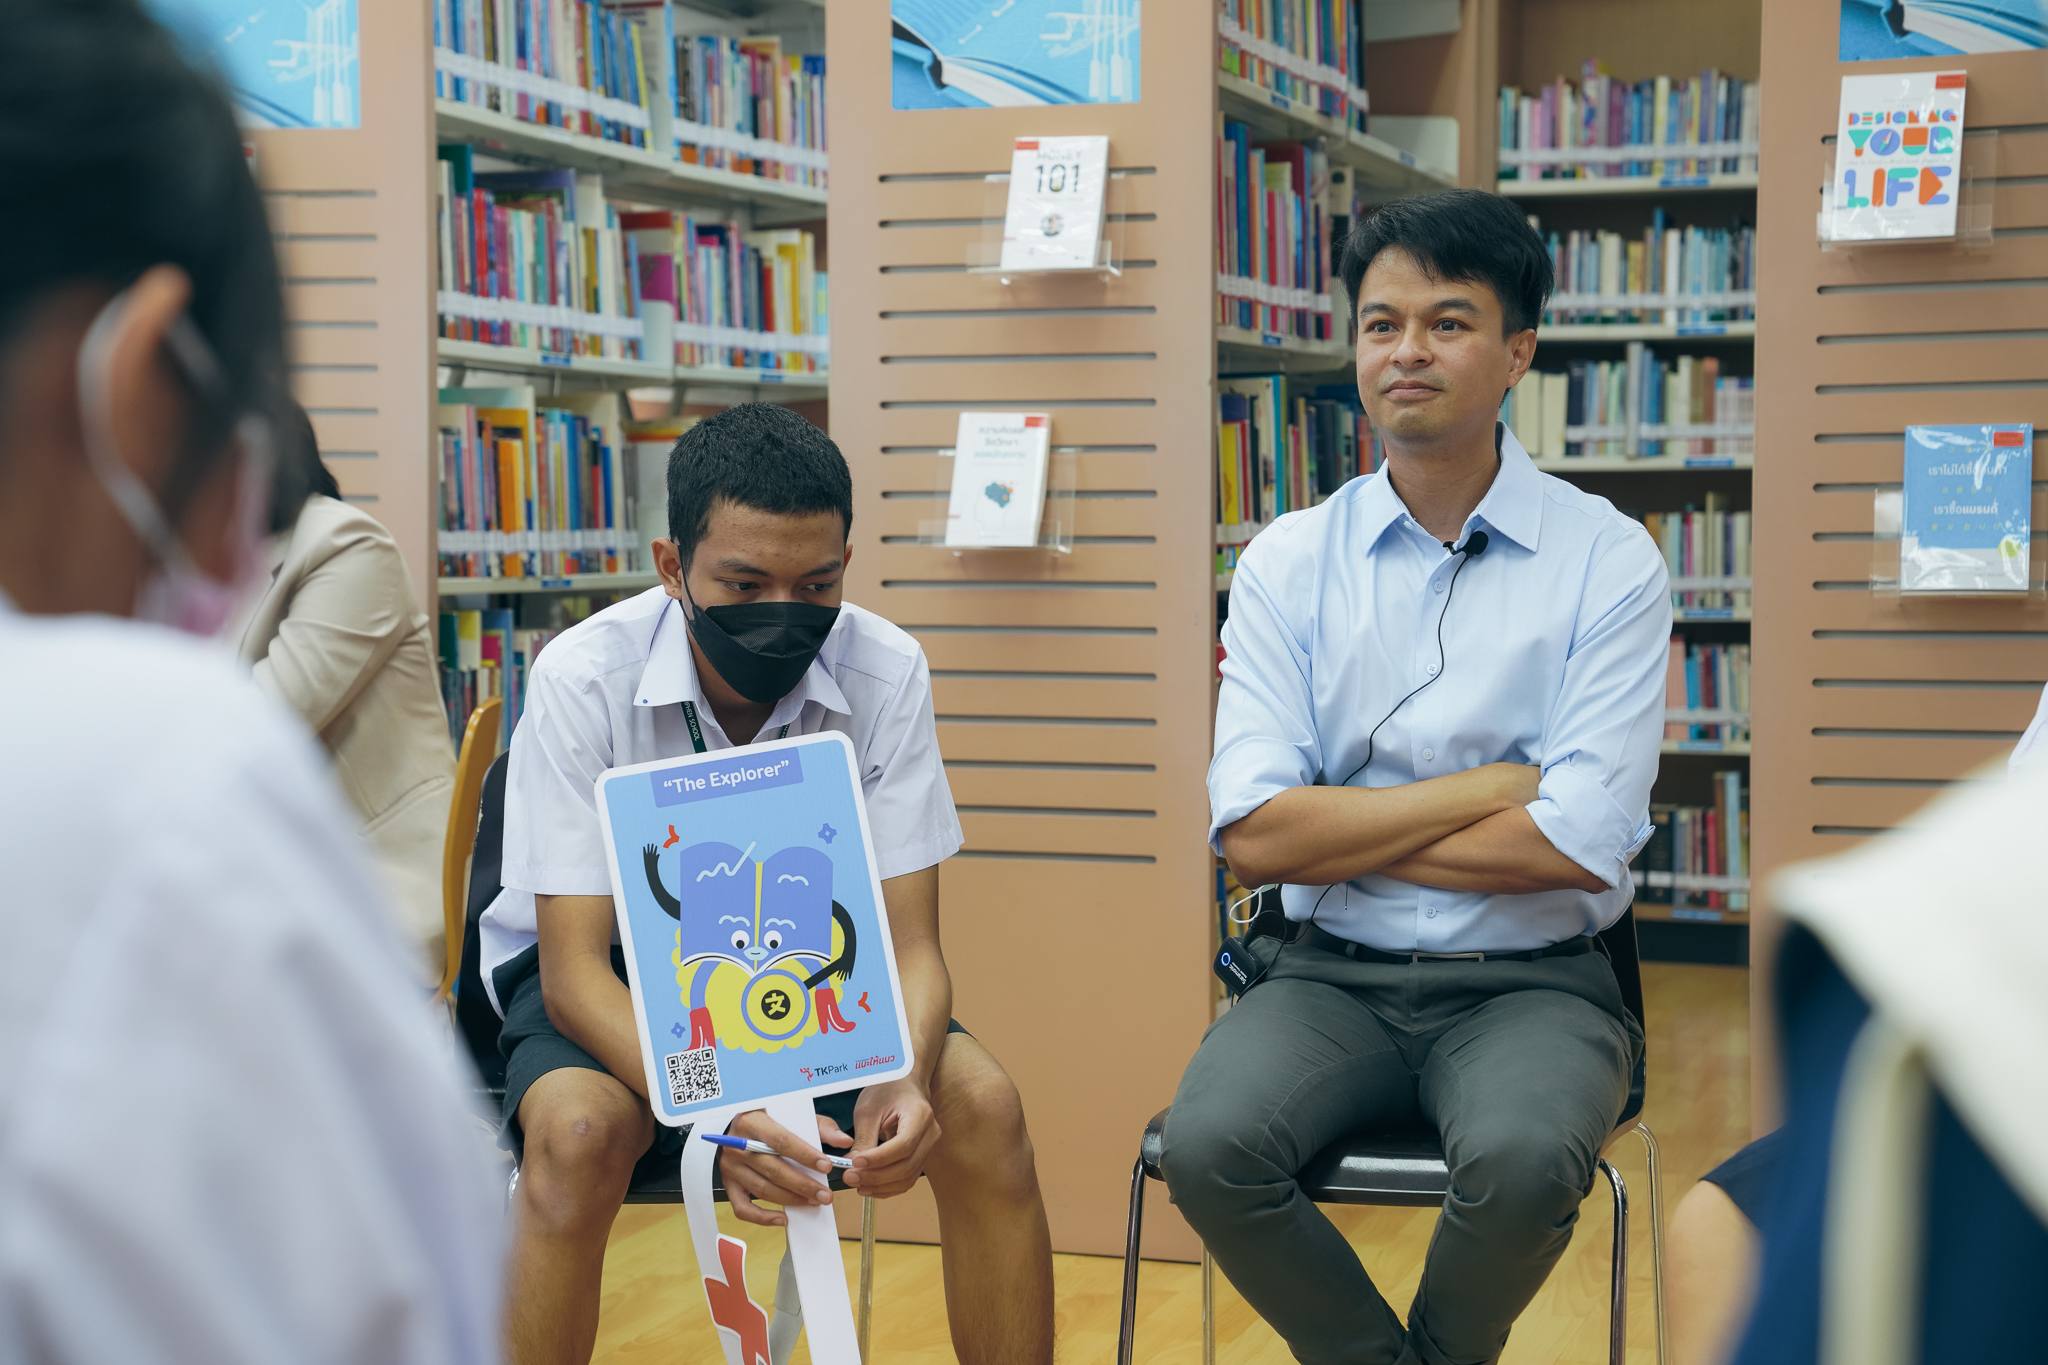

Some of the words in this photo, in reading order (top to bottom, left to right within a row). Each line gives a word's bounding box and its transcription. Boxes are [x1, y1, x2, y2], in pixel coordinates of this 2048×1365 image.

[1848, 126, 1955, 158] YOUR
[1035, 163, 1080, 193] 101
[1844, 166, 1952, 208] LIFE
[689, 718, 700, 741] SCHOOL
